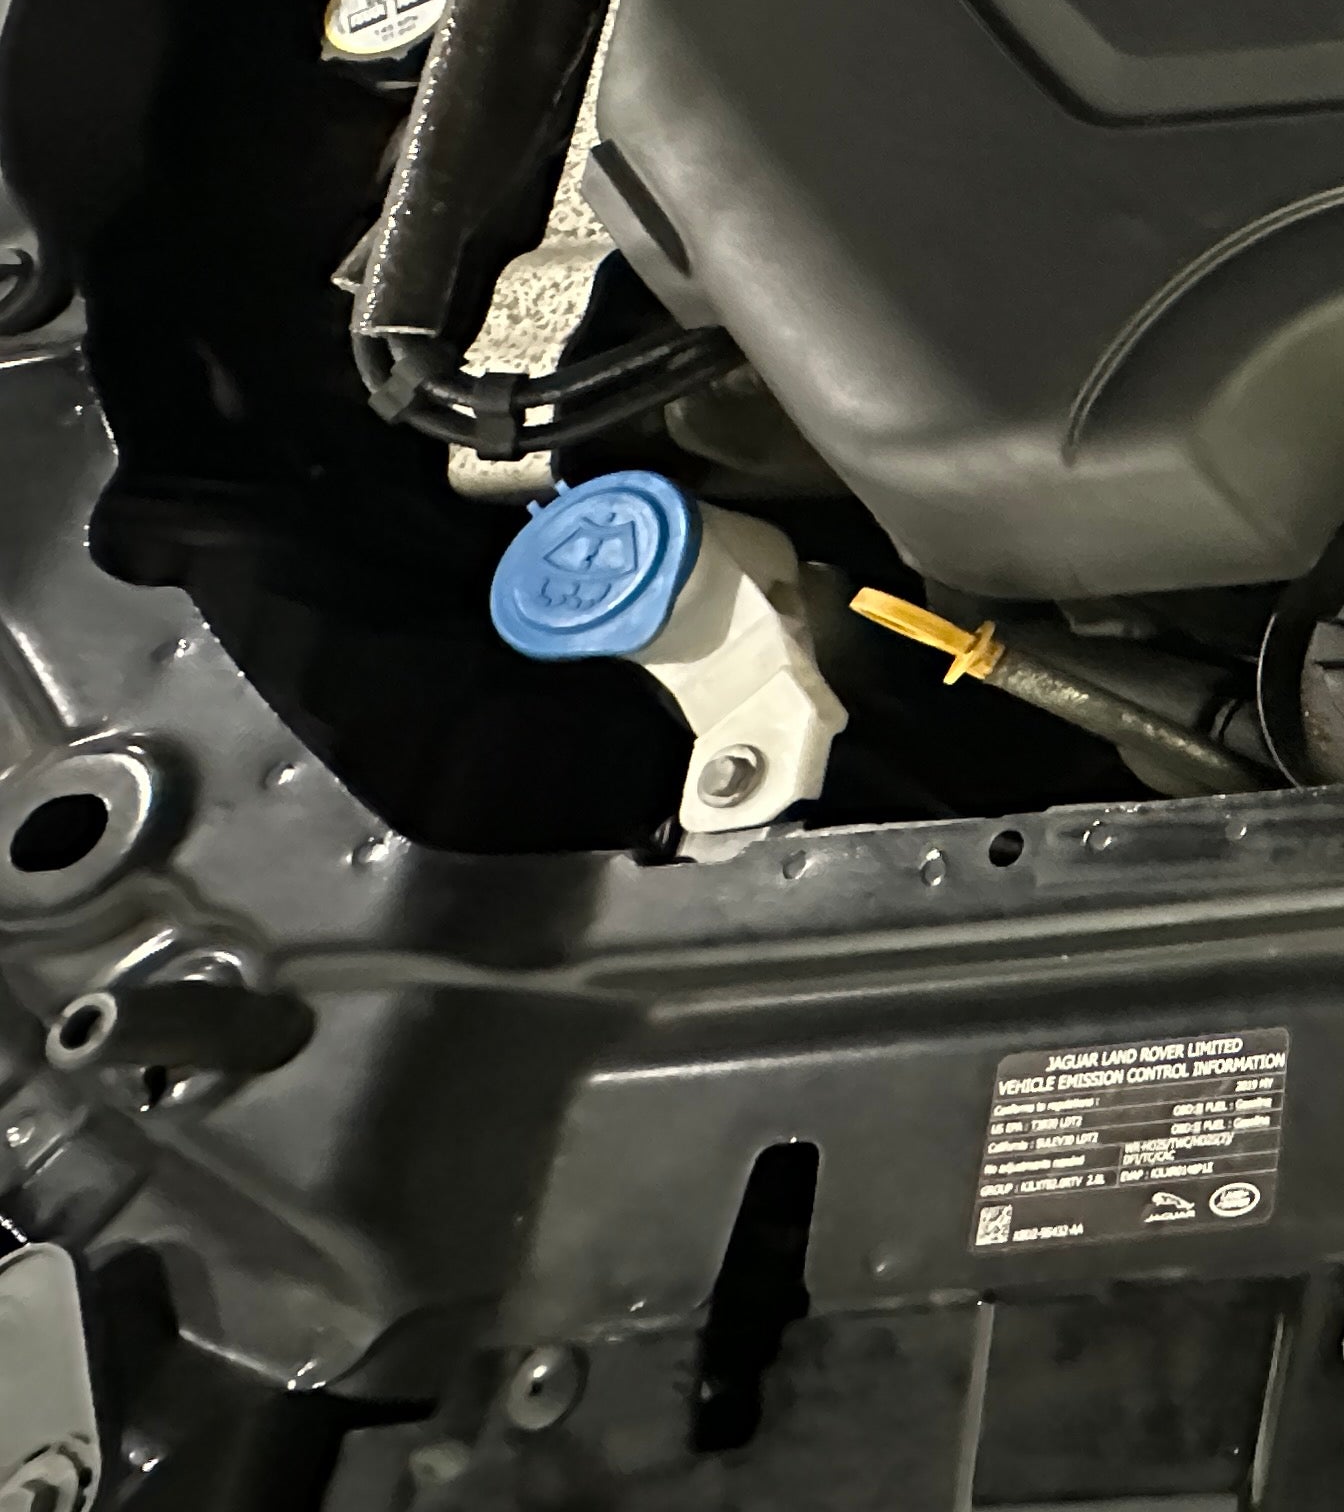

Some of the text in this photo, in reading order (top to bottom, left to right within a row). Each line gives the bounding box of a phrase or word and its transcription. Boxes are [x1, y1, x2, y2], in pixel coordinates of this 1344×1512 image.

[999, 1052, 1286, 1095] VEHICLE EMISSION CONTROL INFORMATION
[1045, 1038, 1243, 1072] JAGUAR LAND ROVER LIMITED
